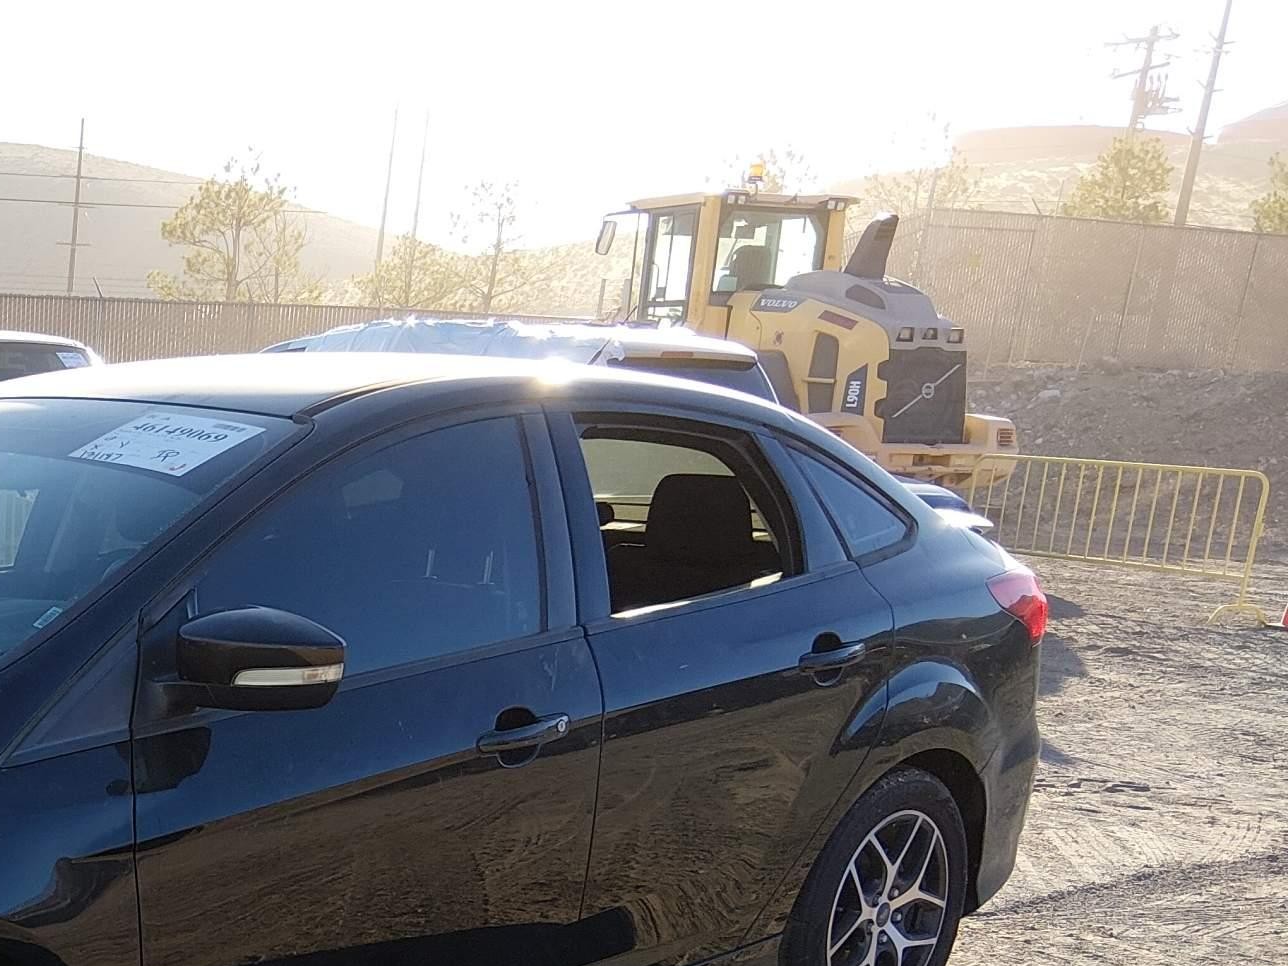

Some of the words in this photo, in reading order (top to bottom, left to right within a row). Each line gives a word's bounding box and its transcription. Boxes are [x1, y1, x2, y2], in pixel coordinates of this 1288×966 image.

[761, 299, 798, 308] VOLVO
[845, 380, 862, 408] L90H
[132, 422, 229, 443] 46149069
